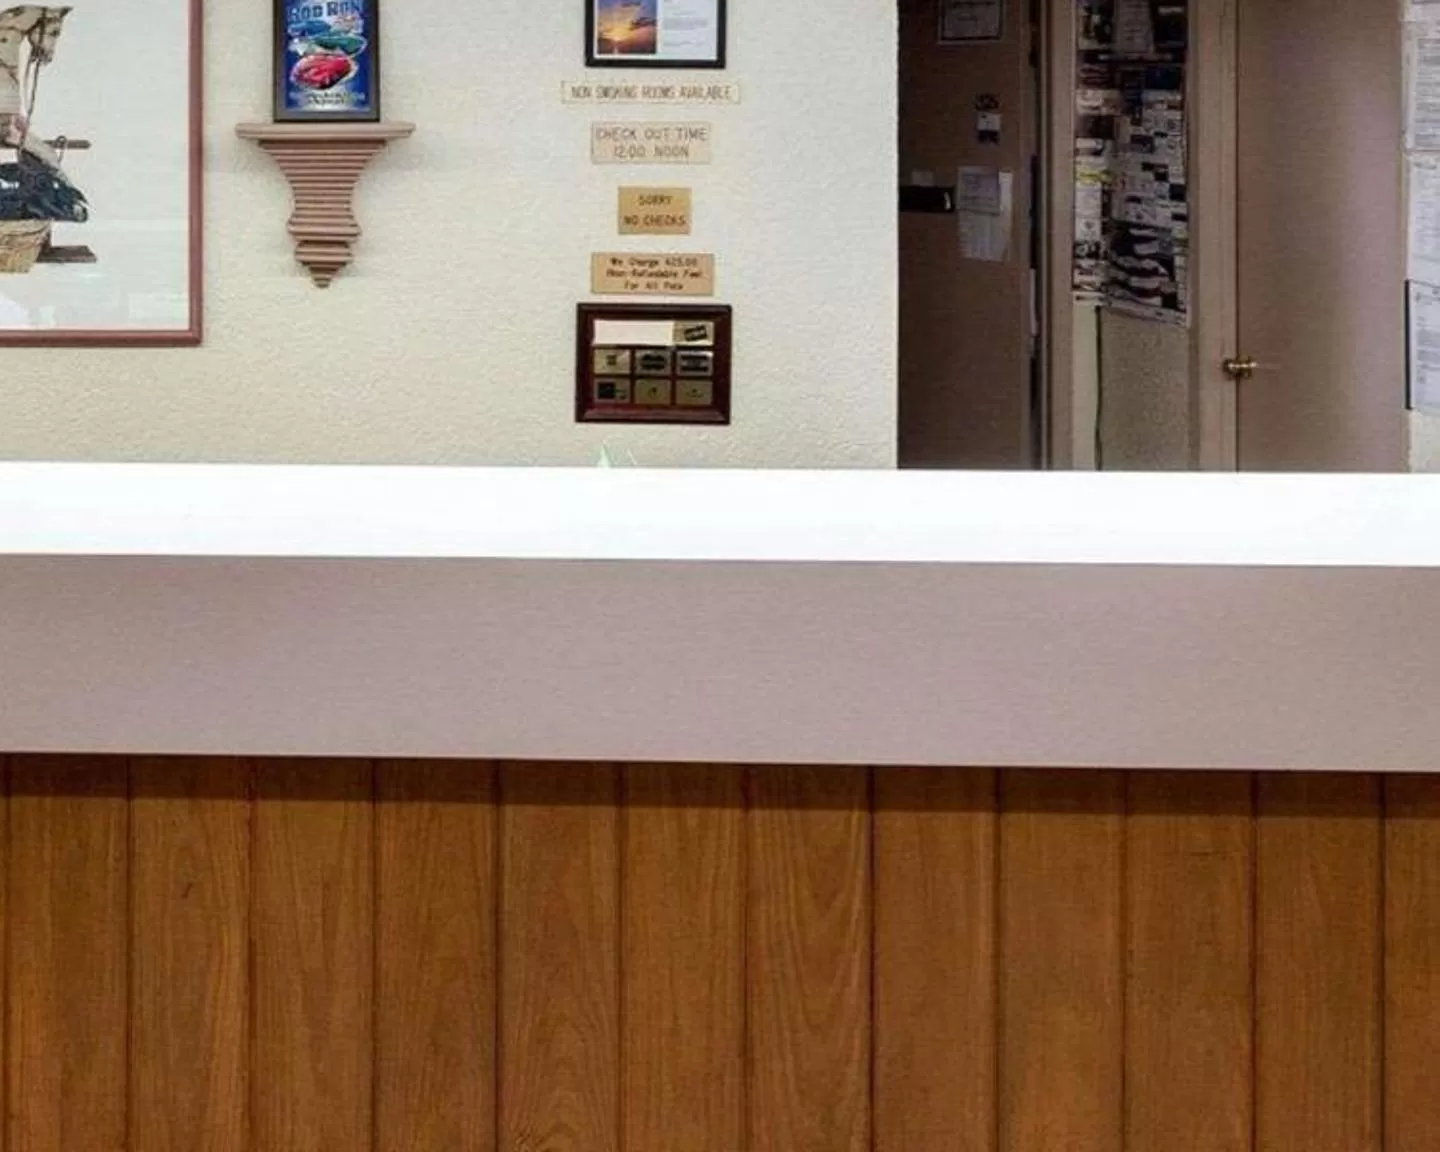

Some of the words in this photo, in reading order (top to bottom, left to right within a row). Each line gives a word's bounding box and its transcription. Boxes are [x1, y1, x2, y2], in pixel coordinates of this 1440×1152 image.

[571, 85, 592, 99] NON
[595, 85, 638, 99] SMOKING
[679, 85, 732, 99] AVAILABLE
[596, 128, 637, 141] CHECK
[644, 128, 670, 141] OUT
[676, 127, 708, 141] TIME
[613, 145, 646, 158] 12:00
[654, 145, 689, 158] NOON
[639, 194, 673, 206] SORRY
[623, 214, 640, 226] NO
[643, 214, 687, 227] CHECKS
